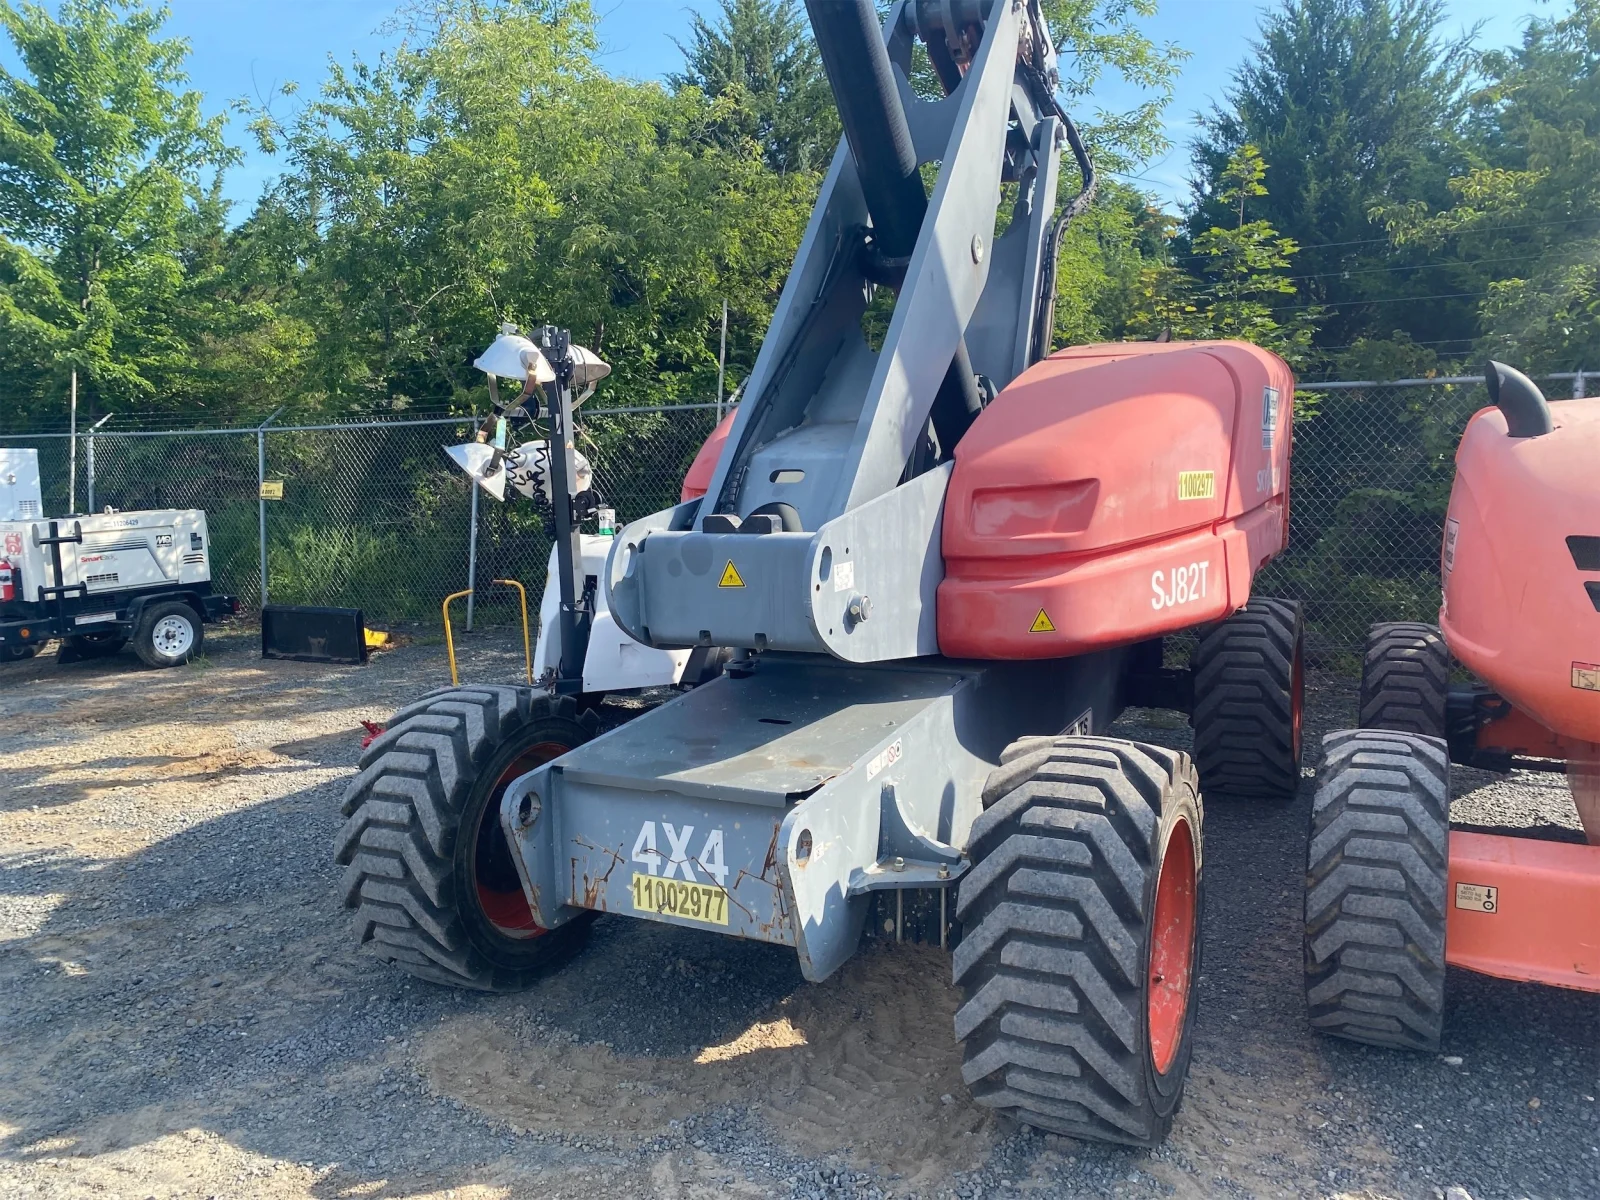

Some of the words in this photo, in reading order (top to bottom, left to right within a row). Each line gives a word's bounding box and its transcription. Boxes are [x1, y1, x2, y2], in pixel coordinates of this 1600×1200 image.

[1178, 472, 1214, 498] 11002977
[1151, 560, 1210, 611] SJ82T
[631, 820, 729, 886] 4X4
[632, 876, 727, 922] 11002977
